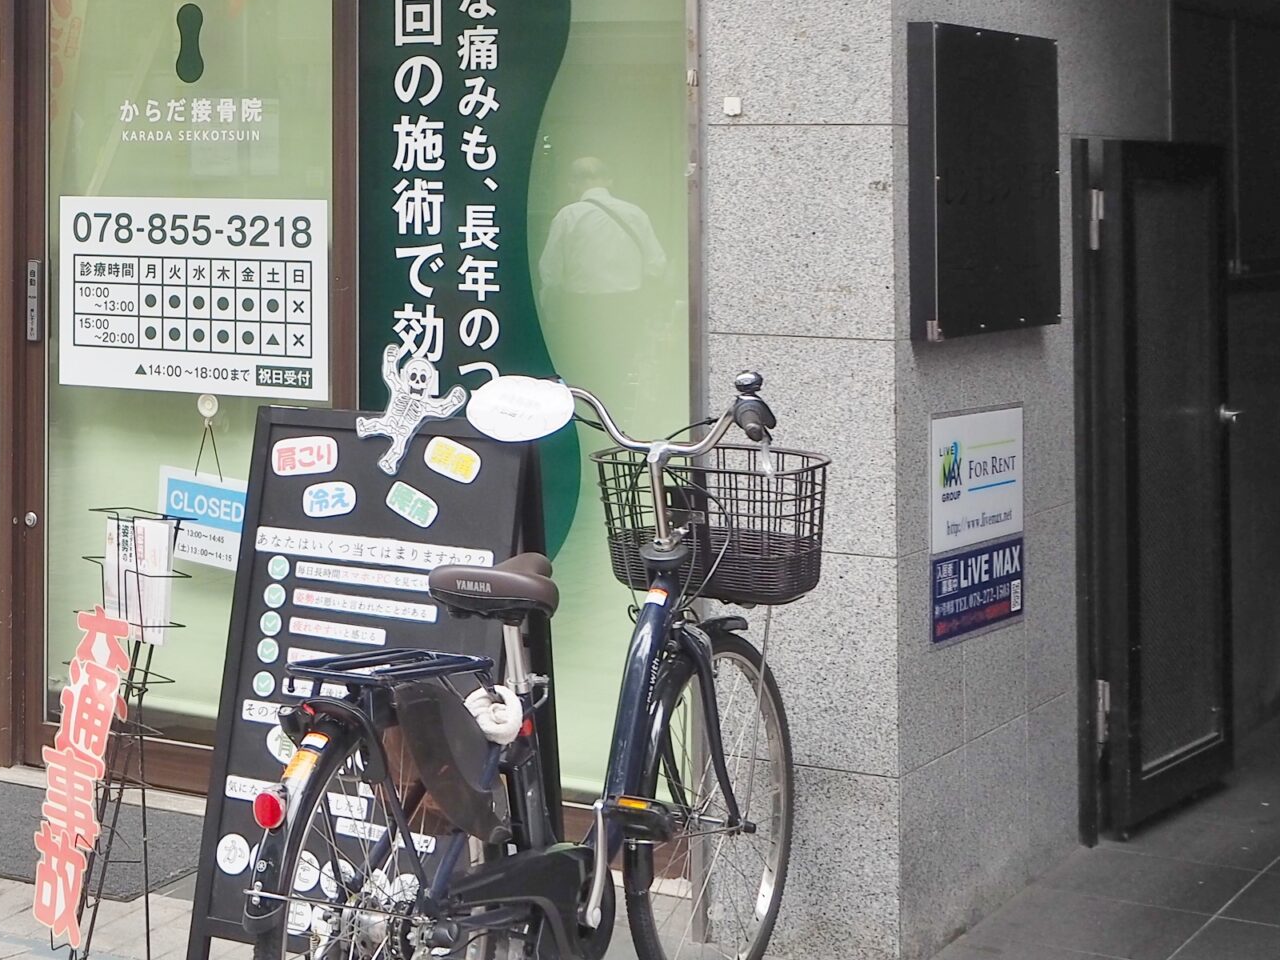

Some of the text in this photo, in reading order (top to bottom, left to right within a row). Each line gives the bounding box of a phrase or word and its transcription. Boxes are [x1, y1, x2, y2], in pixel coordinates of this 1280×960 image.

[119, 97, 264, 123] からだ接骨院
[121, 129, 261, 142] KARADA SEKKOTSUIN
[73, 211, 313, 249] 078-855-3218
[79, 261, 305, 284] 診療時間 月 火 水 木 金 土 日
[79, 286, 110, 299] 10:00
[79, 318, 110, 330] 15:00
[257, 367, 312, 387] 祝日受付
[276, 443, 332, 472] 肩こり
[942, 457, 962, 488] MAX
[170, 490, 244, 523] CLOSED
[308, 487, 350, 513] 冷え
[941, 490, 962, 503] GROUP
[992, 545, 1021, 579] MAX
[455, 579, 492, 593] YAMAHA
[32, 604, 130, 948] 交通事故
